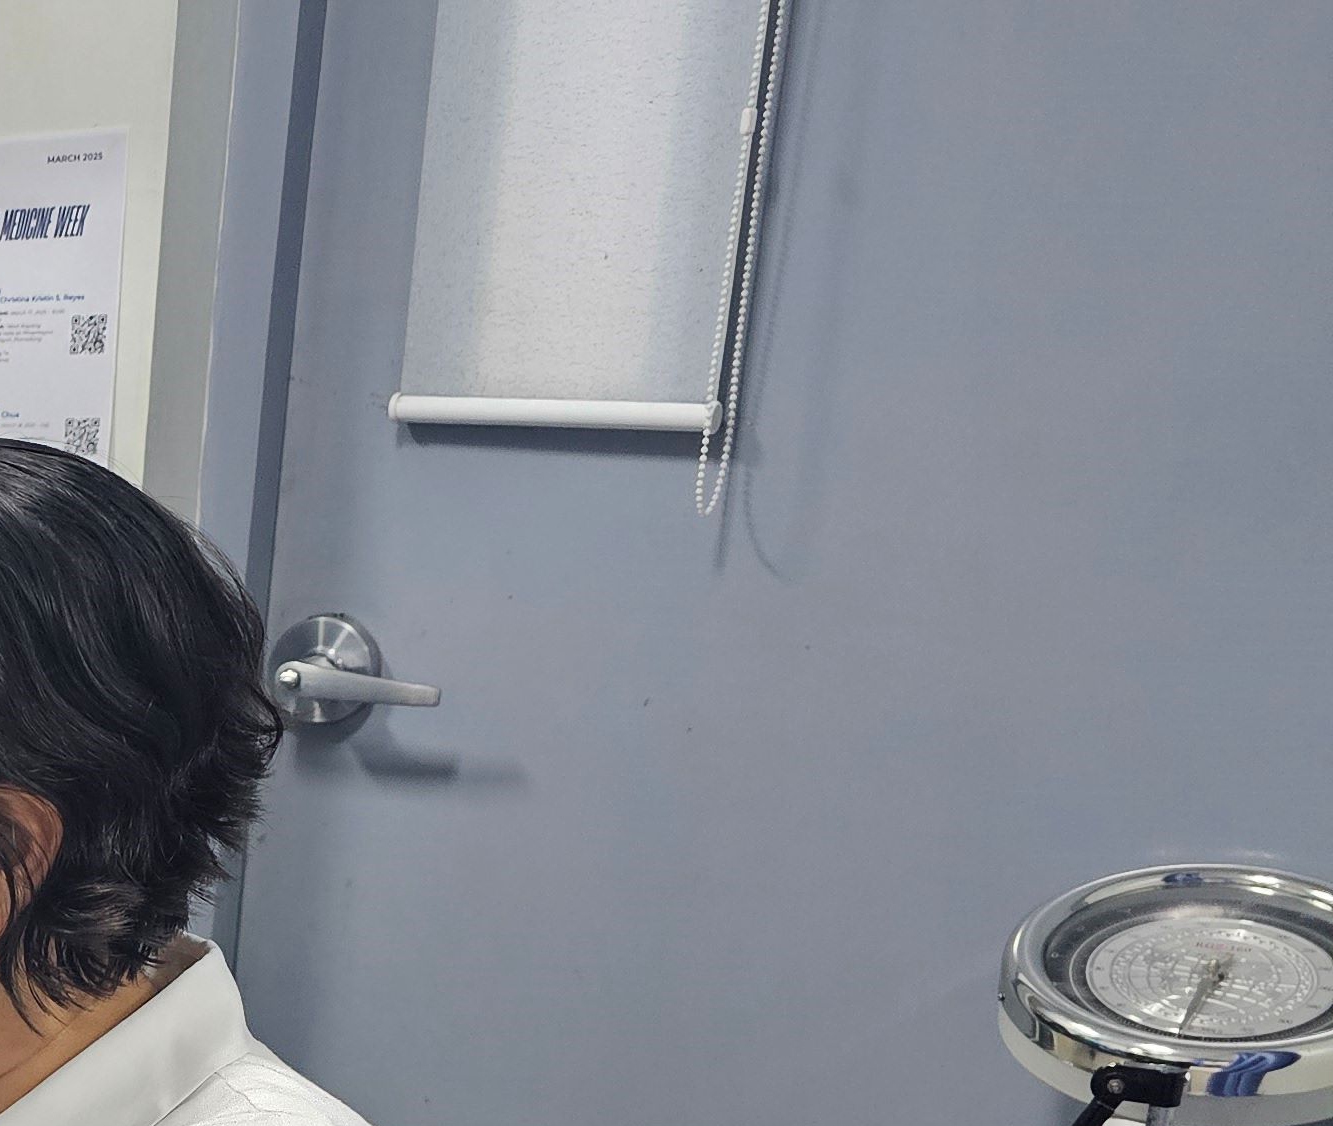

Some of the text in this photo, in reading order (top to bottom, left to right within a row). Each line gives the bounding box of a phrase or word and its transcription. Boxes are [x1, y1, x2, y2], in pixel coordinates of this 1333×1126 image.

[47, 152, 103, 164] MARCH 2025
[0, 206, 55, 241] MEDICINE
[53, 204, 91, 238] WEEK
